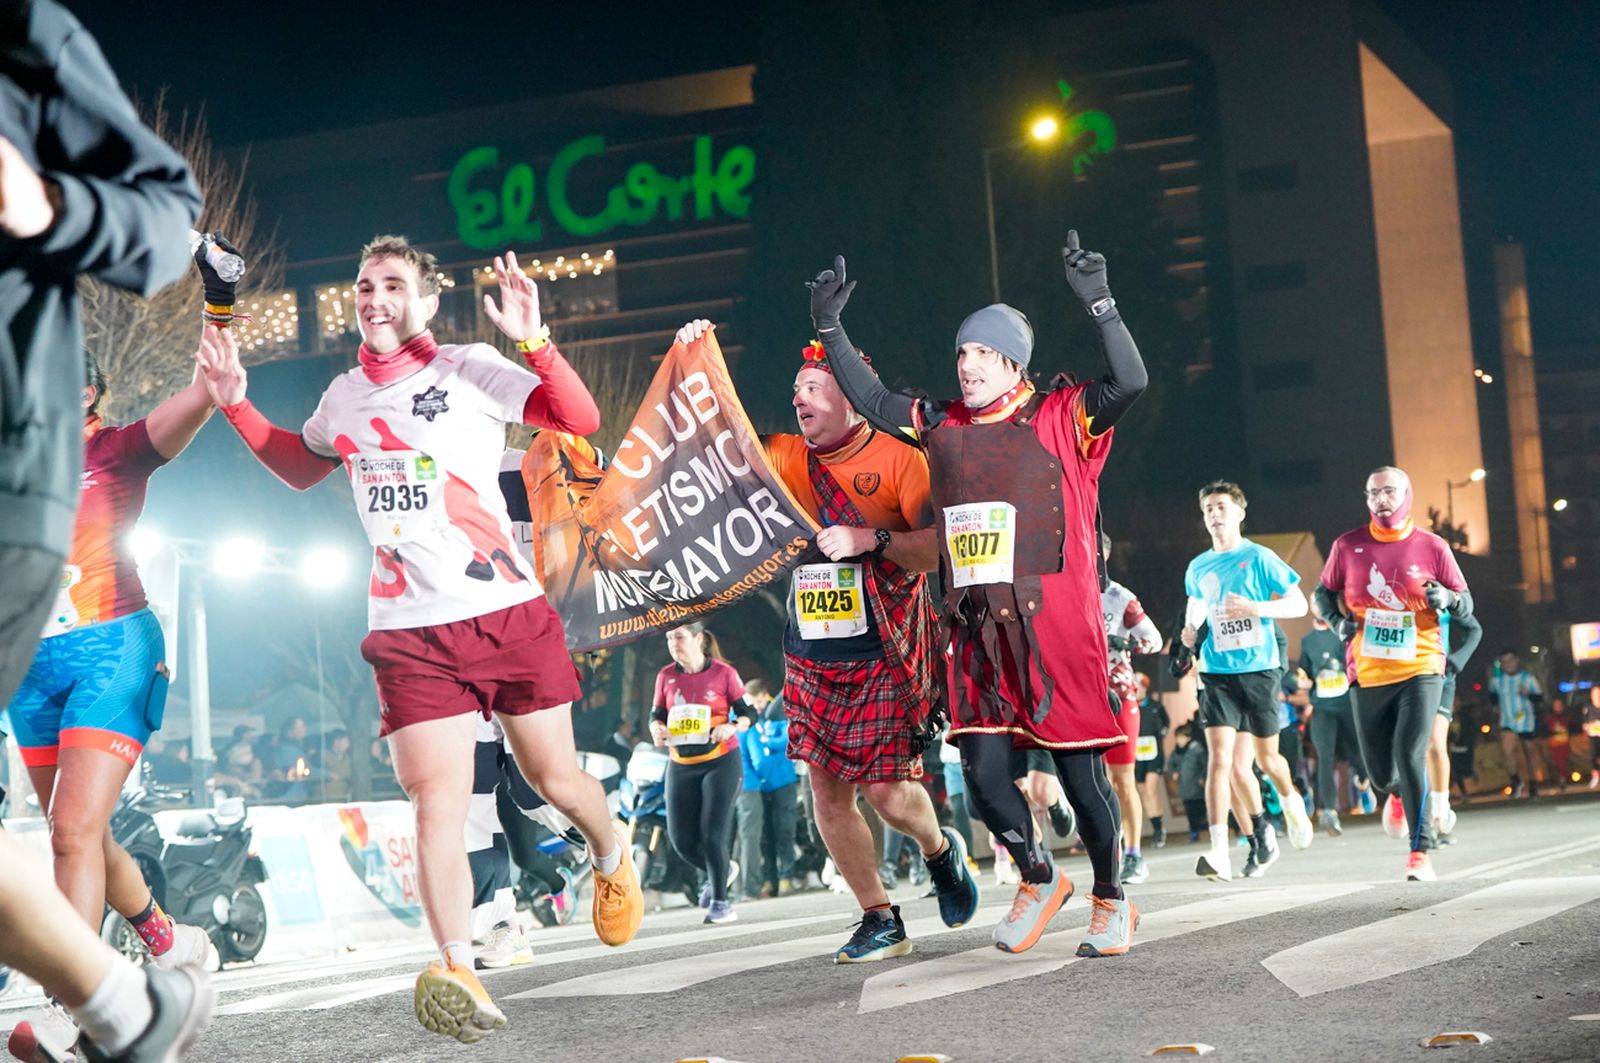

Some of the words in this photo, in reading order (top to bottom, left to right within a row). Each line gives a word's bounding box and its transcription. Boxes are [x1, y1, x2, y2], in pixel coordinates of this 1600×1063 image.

[448, 146, 543, 249] El
[548, 134, 757, 236] Corte
[612, 371, 720, 479] CLUB
[368, 484, 429, 512] 2935
[953, 532, 1000, 559] 13077
[800, 590, 853, 613] 12425
[1220, 618, 1252, 635] 3539
[1374, 627, 1405, 643] 7941
[387, 837, 415, 868] SA
